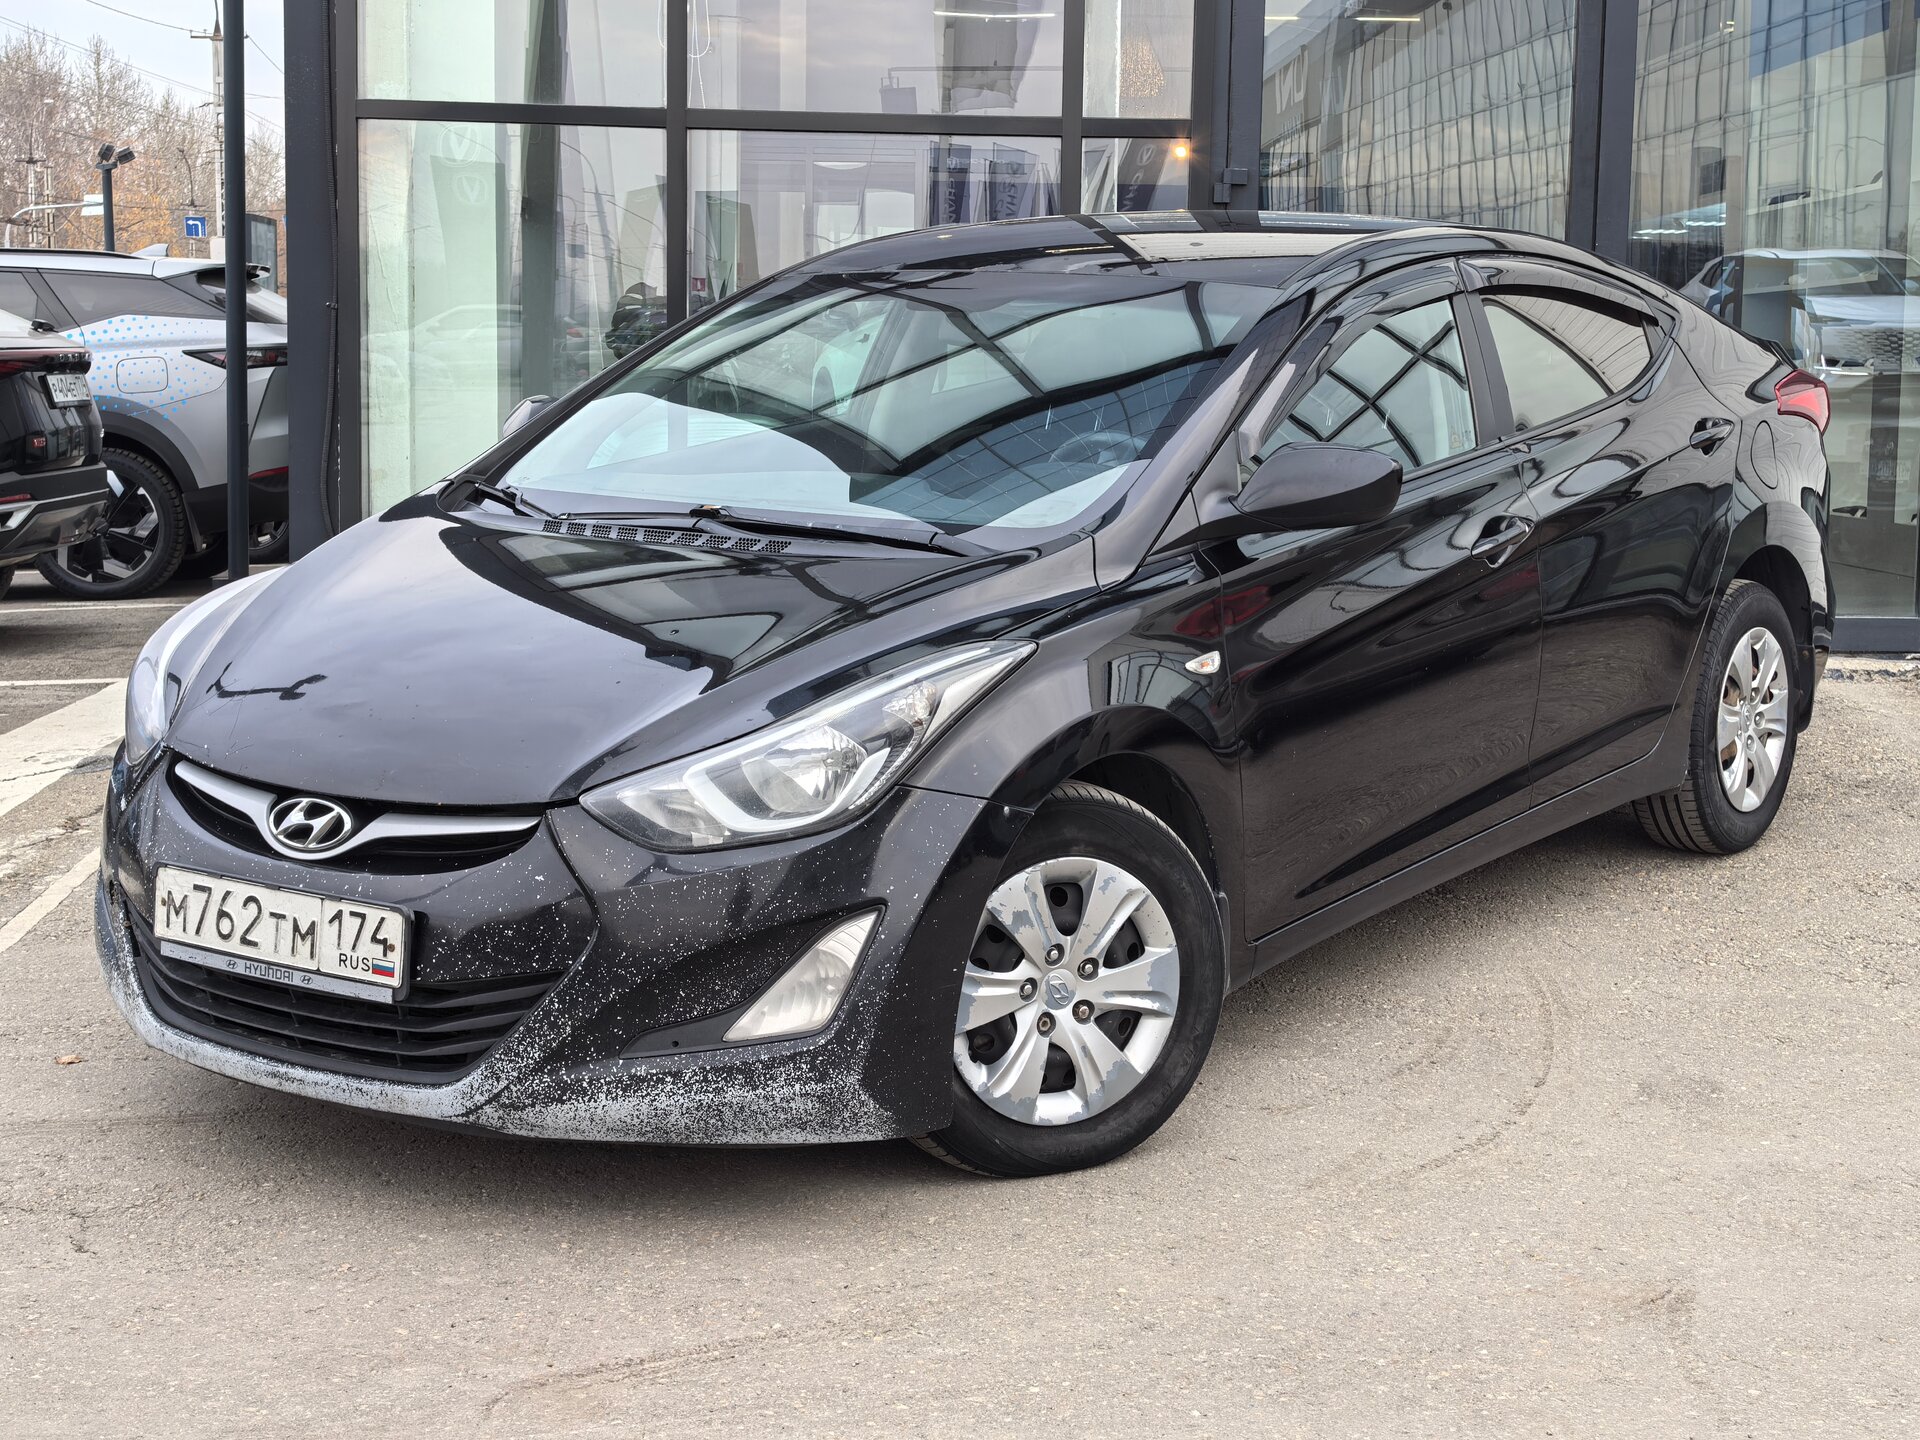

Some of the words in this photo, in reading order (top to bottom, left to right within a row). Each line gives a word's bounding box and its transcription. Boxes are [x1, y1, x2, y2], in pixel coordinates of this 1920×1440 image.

[328, 909, 389, 957] 174
[244, 961, 294, 983] HYUNDAI
[338, 953, 371, 972] RUS
